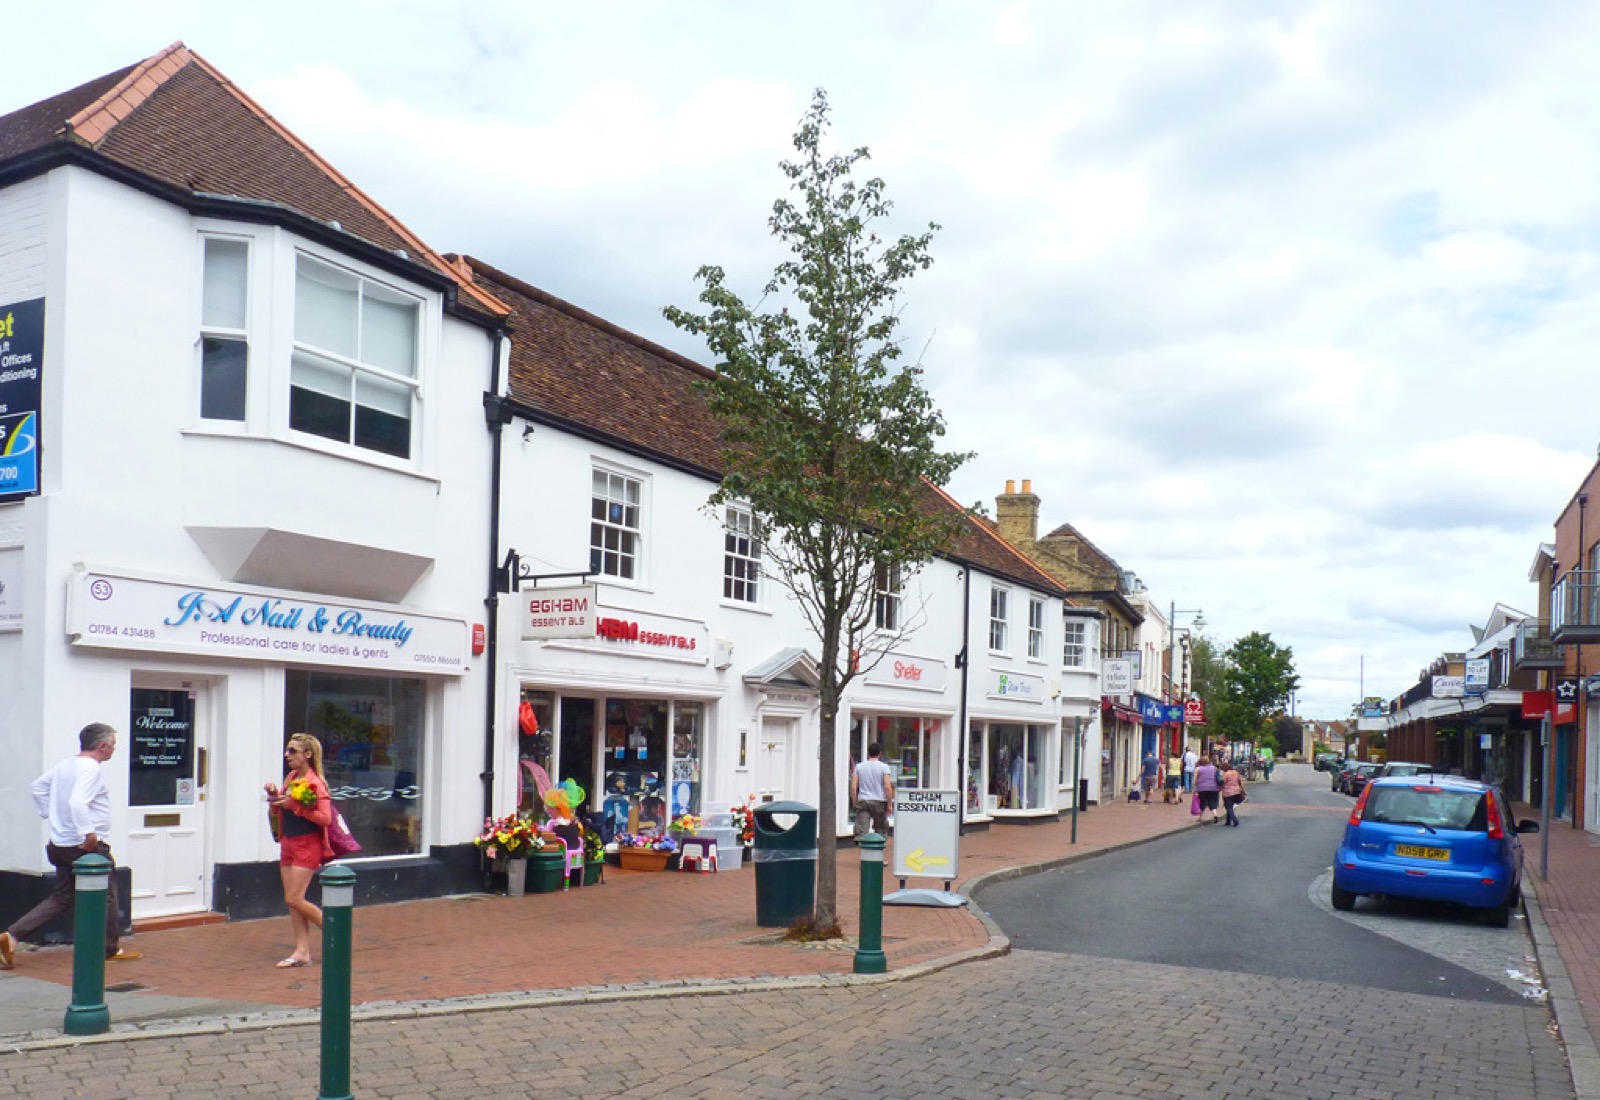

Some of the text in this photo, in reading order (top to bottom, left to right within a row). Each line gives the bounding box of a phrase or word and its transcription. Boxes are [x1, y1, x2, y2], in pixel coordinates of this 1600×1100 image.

[1, 354, 32, 368] Offices
[94, 583, 109, 596] 53
[89, 623, 118, 636] 01784
[241, 599, 304, 630] Nail
[308, 607, 329, 634] &
[333, 610, 414, 649] Beauty
[200, 631, 389, 661] Professional care for ladies & gents
[136, 716, 189, 729] Welcome
[908, 792, 942, 802] EGHAM
[897, 803, 957, 813] ESSENTIALS
